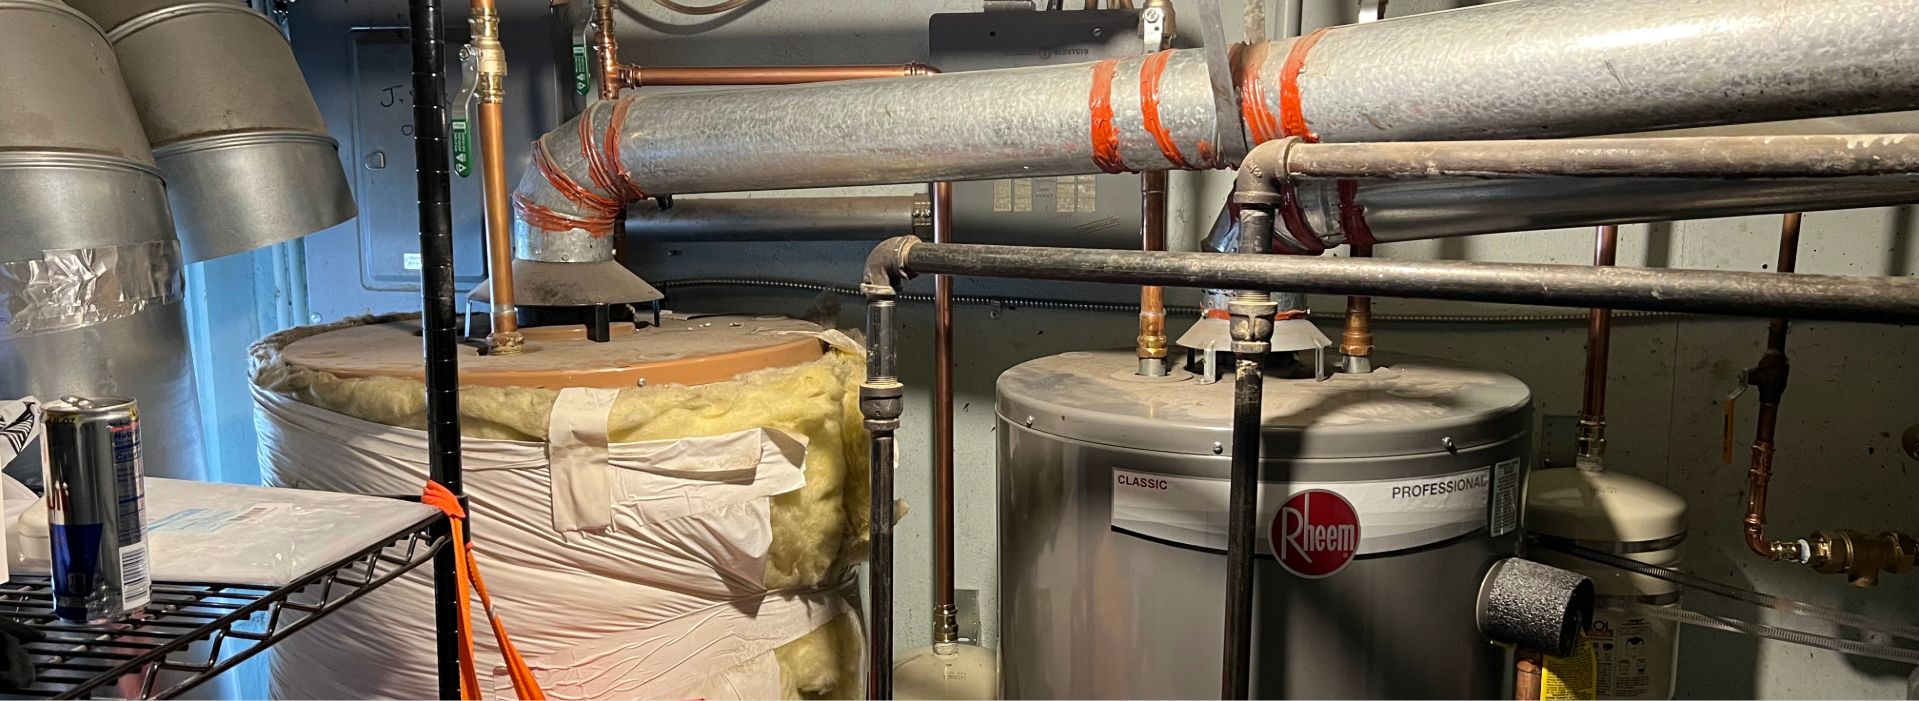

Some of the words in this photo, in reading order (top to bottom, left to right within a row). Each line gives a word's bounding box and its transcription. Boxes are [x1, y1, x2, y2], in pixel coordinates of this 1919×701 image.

[1117, 474, 1168, 490] CLASSIC
[1391, 475, 1488, 499] PROFESSIONAL
[1280, 492, 1355, 564] Rheem
